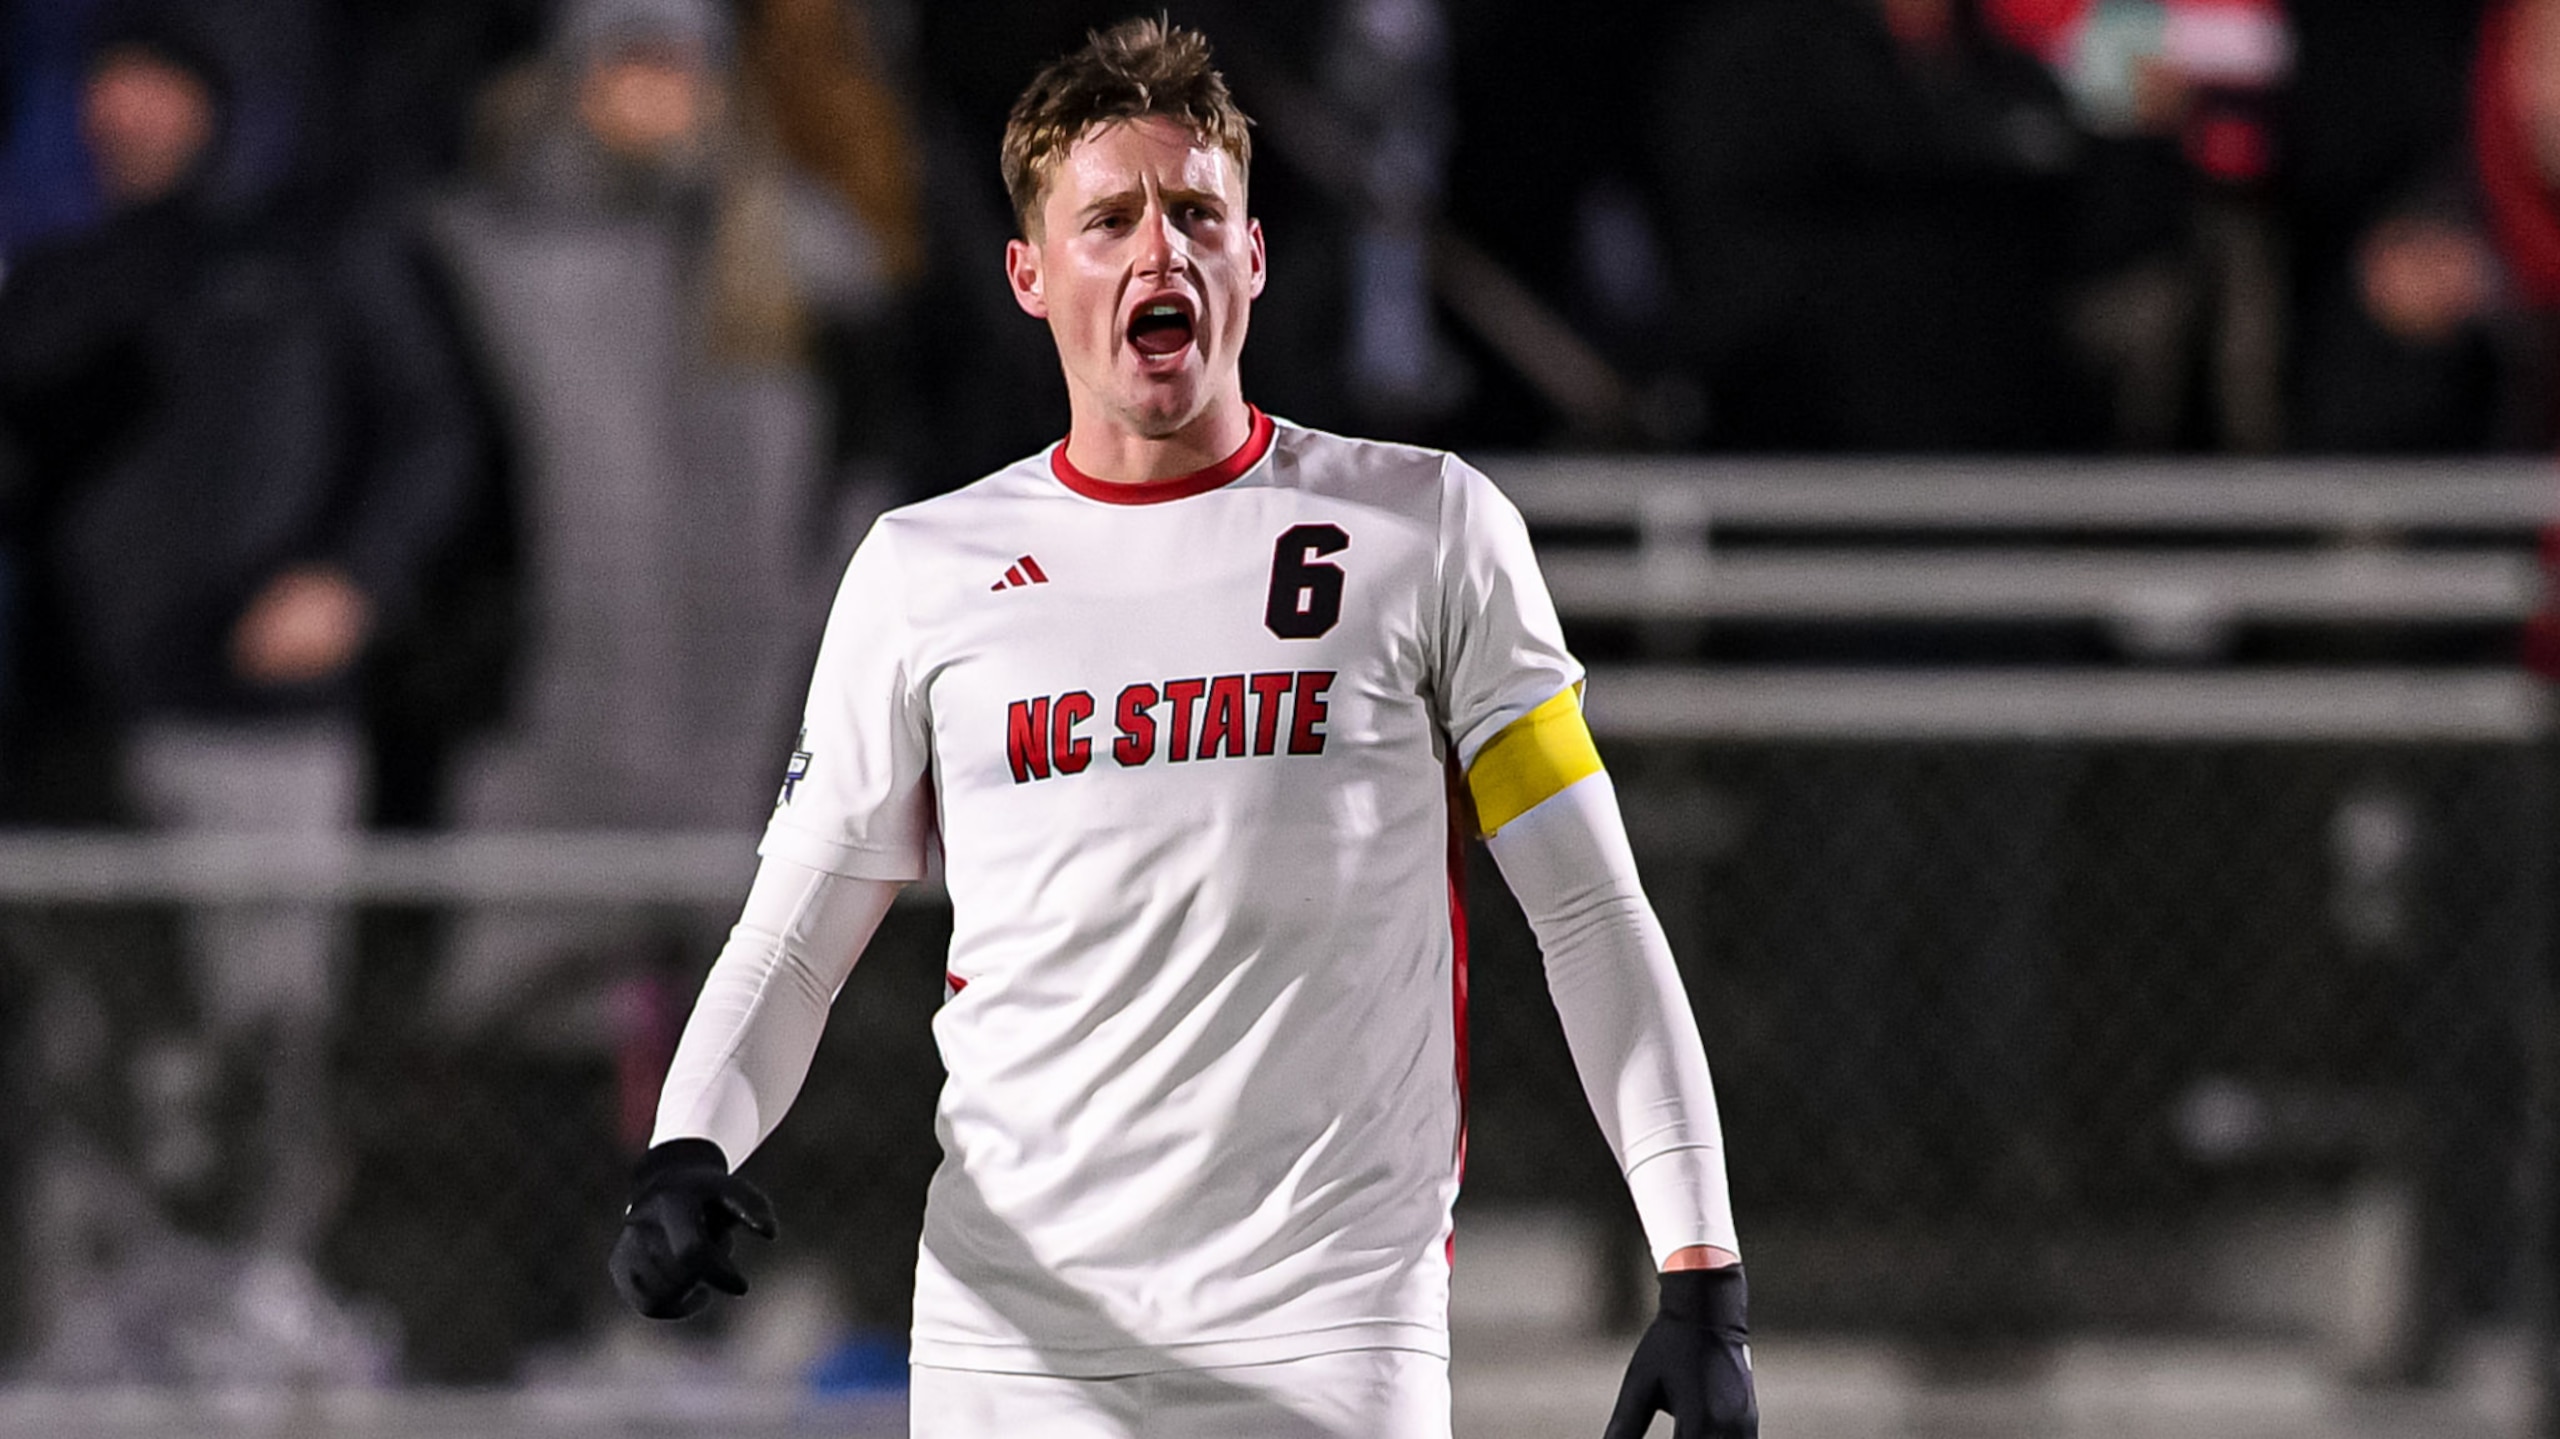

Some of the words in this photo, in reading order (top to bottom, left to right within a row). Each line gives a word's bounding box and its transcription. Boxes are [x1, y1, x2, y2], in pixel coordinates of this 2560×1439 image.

[1264, 523, 1350, 640] 6
[1007, 690, 1095, 784] NC
[1113, 671, 1338, 767] STATE
